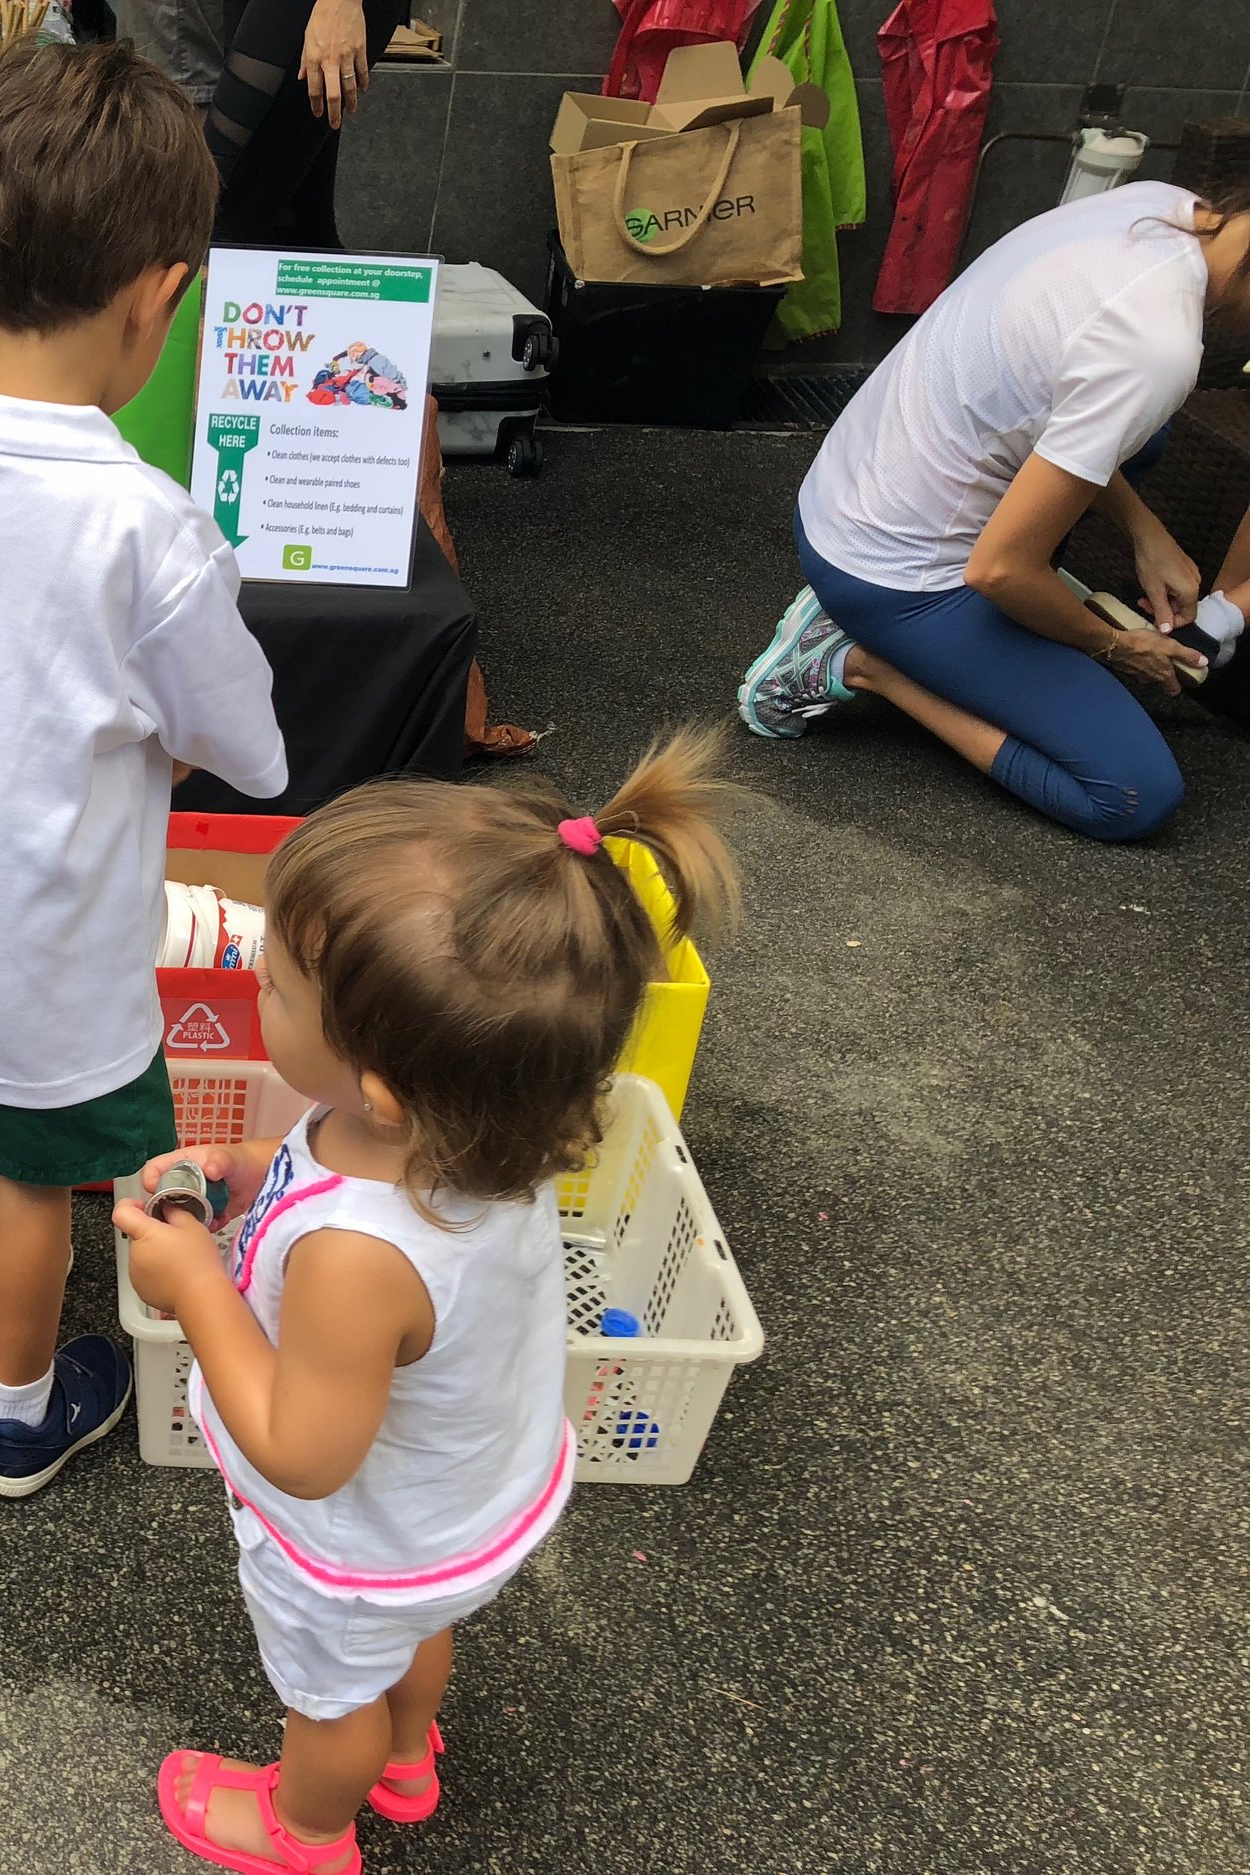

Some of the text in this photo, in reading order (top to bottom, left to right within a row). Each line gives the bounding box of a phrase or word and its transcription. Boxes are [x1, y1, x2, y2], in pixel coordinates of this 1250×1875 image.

[278, 262, 292, 270] For
[312, 265, 351, 274] collection
[364, 268, 383, 276] your
[384, 268, 424, 279] doorstep,
[278, 275, 380, 288] schedule appointment @
[276, 287, 380, 299] www.greensquare.com.sg
[223, 302, 308, 326] DON'T
[214, 326, 315, 352] THROW
[224, 353, 294, 377] THEM
[220, 379, 298, 402] AWAY
[211, 416, 256, 430] RECYCLE
[270, 424, 339, 438] Collection items:
[218, 434, 246, 448] HERE
[272, 450, 410, 468] Clean clothes (we accept clothes with defects too)
[270, 475, 360, 488] Clean and wearable paired shoes
[268, 499, 283, 508] Clean
[284, 500, 314, 510] household
[314, 501, 328, 510] linen
[343, 502, 366, 515] bedding
[366, 505, 378, 514] and
[379, 506, 404, 516] curtains)
[265, 523, 297, 533] Accessories
[312, 525, 325, 534] belts
[326, 527, 337, 535] and
[338, 526, 354, 538] bags)
[290, 551, 305, 566] G
[312, 564, 399, 574] www.greensquare.com.sg
[183, 1032, 214, 1040] PLASTIC
